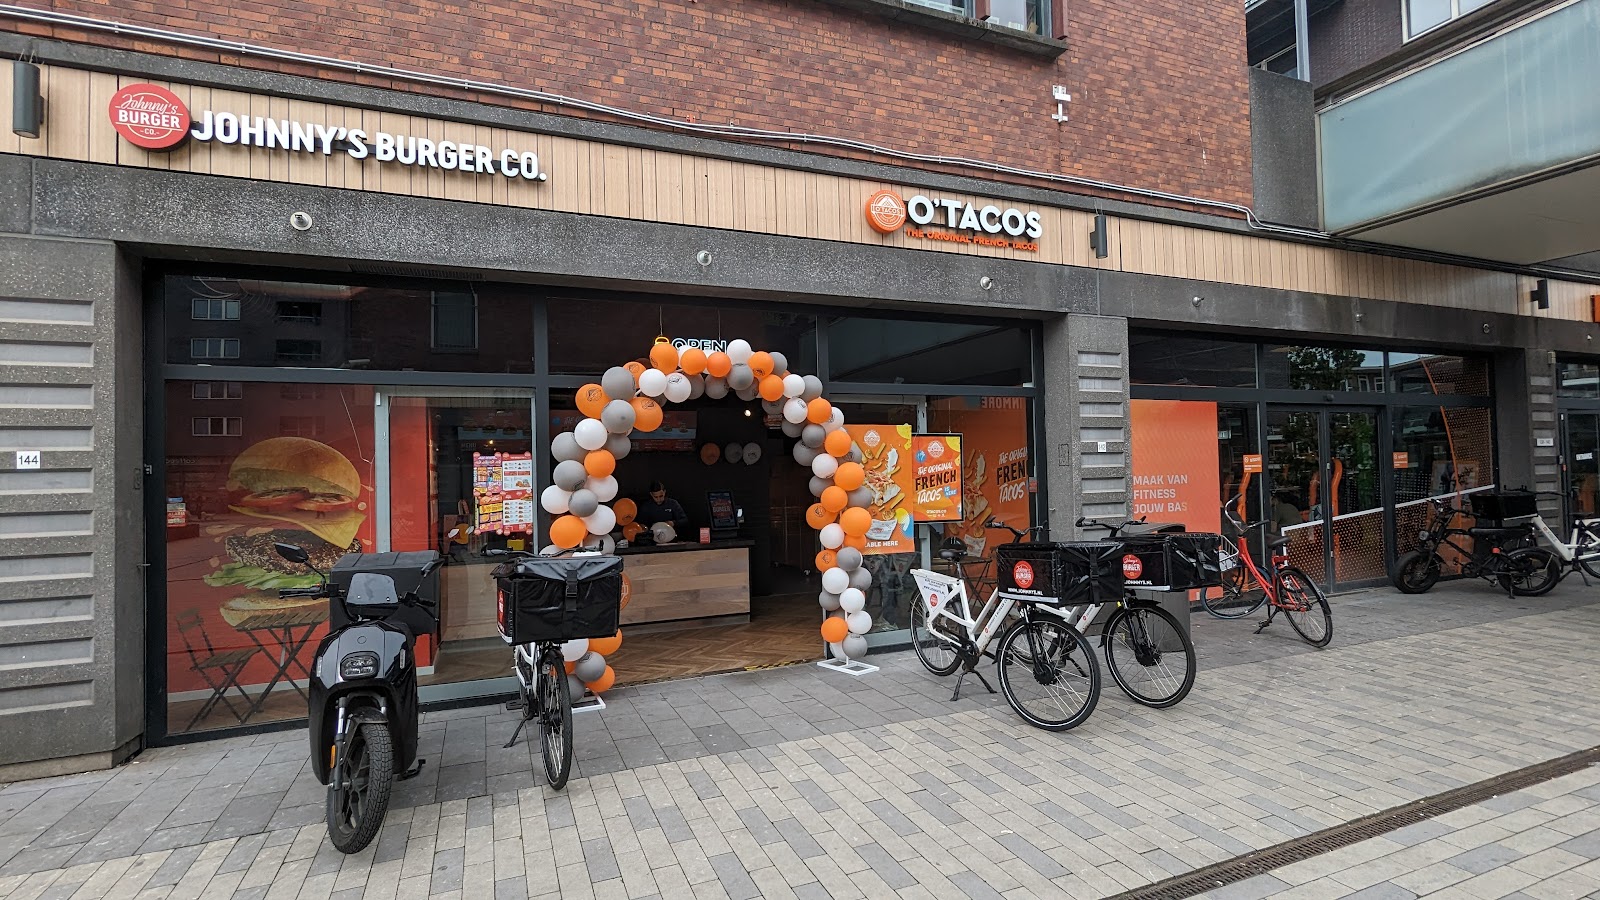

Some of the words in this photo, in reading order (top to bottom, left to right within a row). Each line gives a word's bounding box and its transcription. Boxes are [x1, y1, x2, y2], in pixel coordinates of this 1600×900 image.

[120, 93, 178, 114] Johnny's
[118, 109, 181, 129] BURGER
[190, 110, 369, 159] JOHNNY'S
[375, 131, 496, 174] BURGER
[500, 148, 548, 181] CO.
[907, 195, 1043, 239] O'TACOS
[906, 228, 924, 238] THE
[927, 231, 971, 244] ORIGINAL
[973, 236, 1009, 248] FRENCH
[1011, 241, 1039, 252] TACOS
[18, 455, 39, 465] 144
[1009, 446, 1028, 461] ORIGI
[917, 467, 928, 475] THE
[928, 462, 953, 474] ORIGINAL
[996, 460, 1027, 485] FREN
[915, 469, 957, 491] FRENCH
[1133, 475, 1164, 486] MAAK
[1167, 474, 1188, 484] VAN
[917, 488, 943, 505] TACOS
[999, 482, 1026, 503] TACOS
[1133, 488, 1176, 500] FITNESS
[1133, 503, 1164, 514] JOUW
